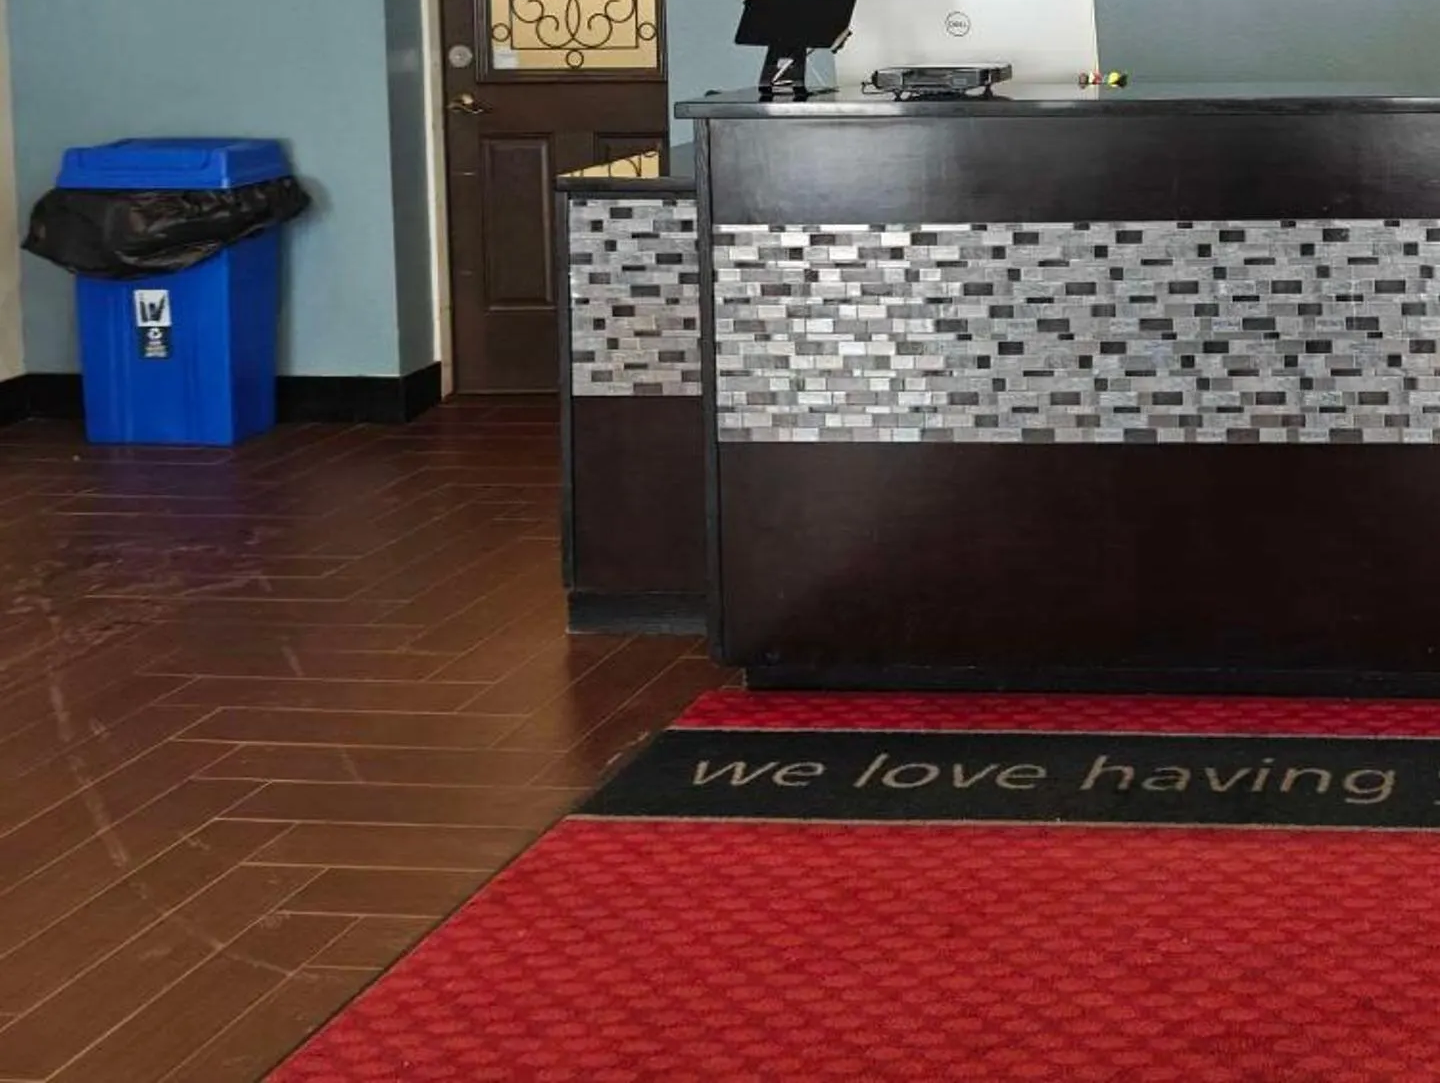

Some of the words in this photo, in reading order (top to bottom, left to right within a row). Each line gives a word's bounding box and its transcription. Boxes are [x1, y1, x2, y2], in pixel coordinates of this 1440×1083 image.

[691, 757, 826, 788] we
[852, 752, 1048, 791] love
[1078, 754, 1395, 805] having
